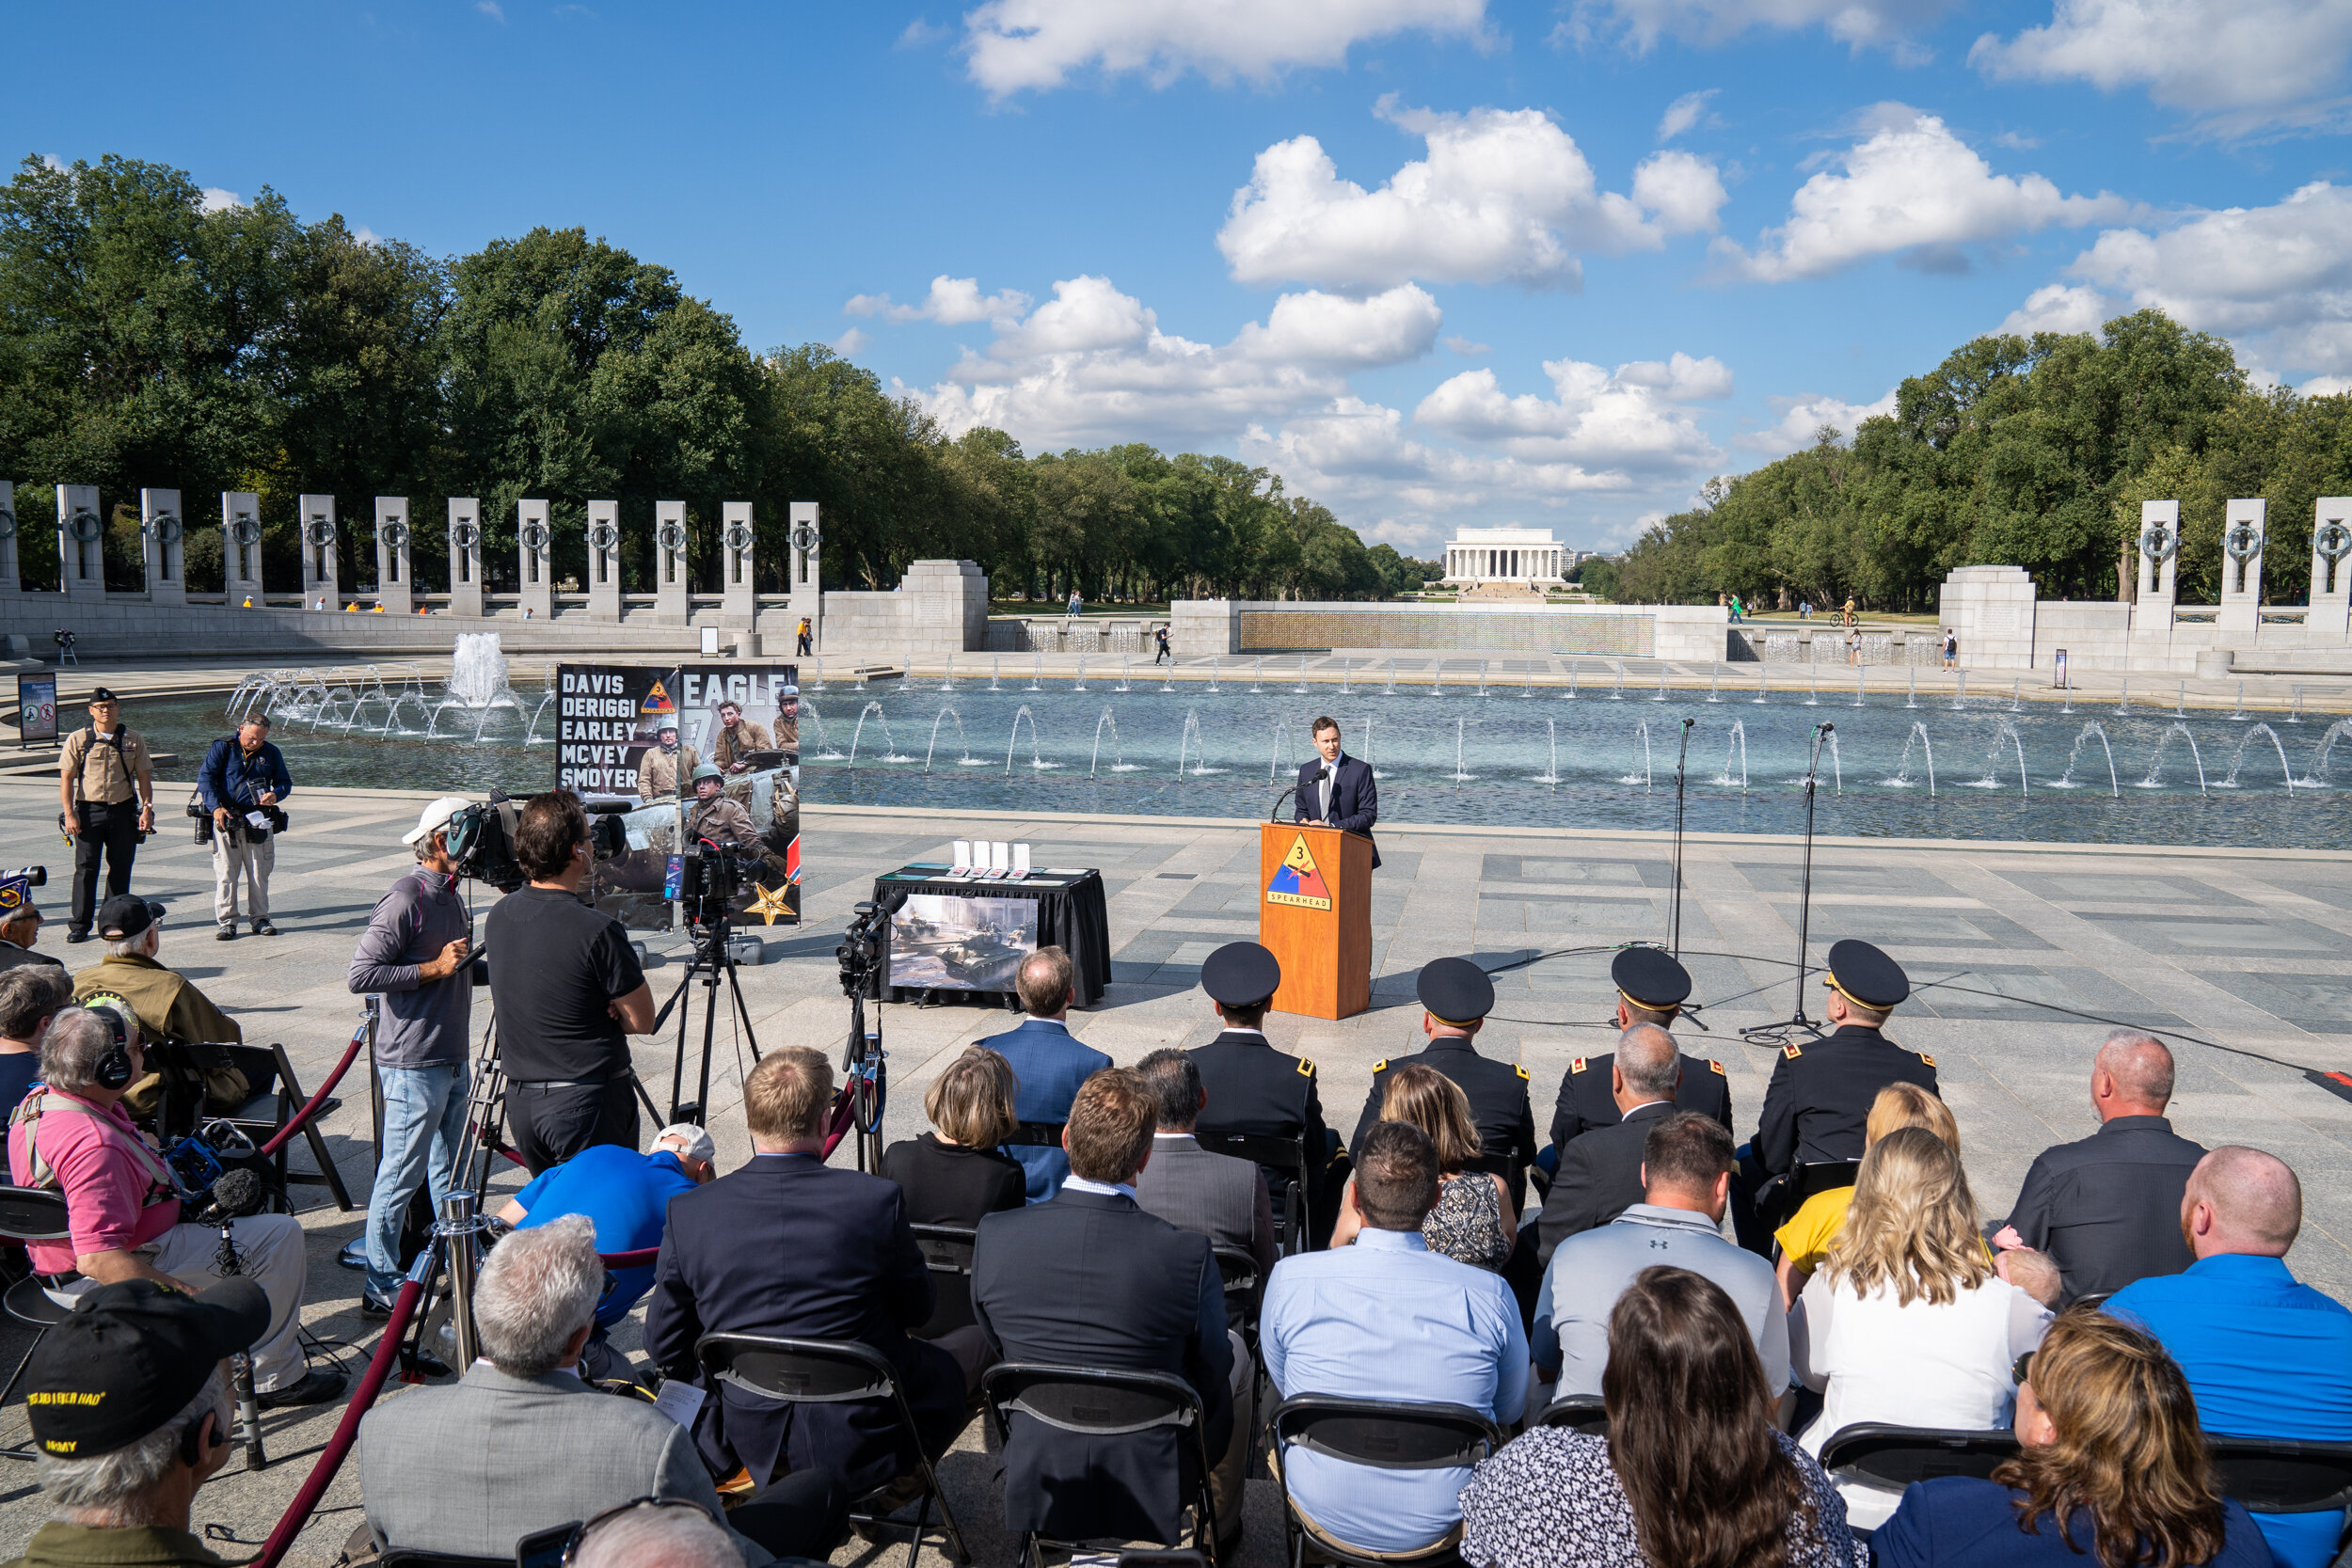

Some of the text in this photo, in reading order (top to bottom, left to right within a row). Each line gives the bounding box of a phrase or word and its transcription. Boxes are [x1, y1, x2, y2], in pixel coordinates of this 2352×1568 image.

[563, 673, 624, 694] DAVIS
[683, 673, 785, 706] EAGLE
[562, 697, 636, 718] DERIGGI
[562, 721, 638, 741] EARLEY
[684, 708, 713, 758] 7
[562, 744, 629, 765] MCVEY
[561, 768, 638, 788] SMOYER
[1296, 846, 1304, 860] 3
[1271, 894, 1327, 907] SPEARHEAD
